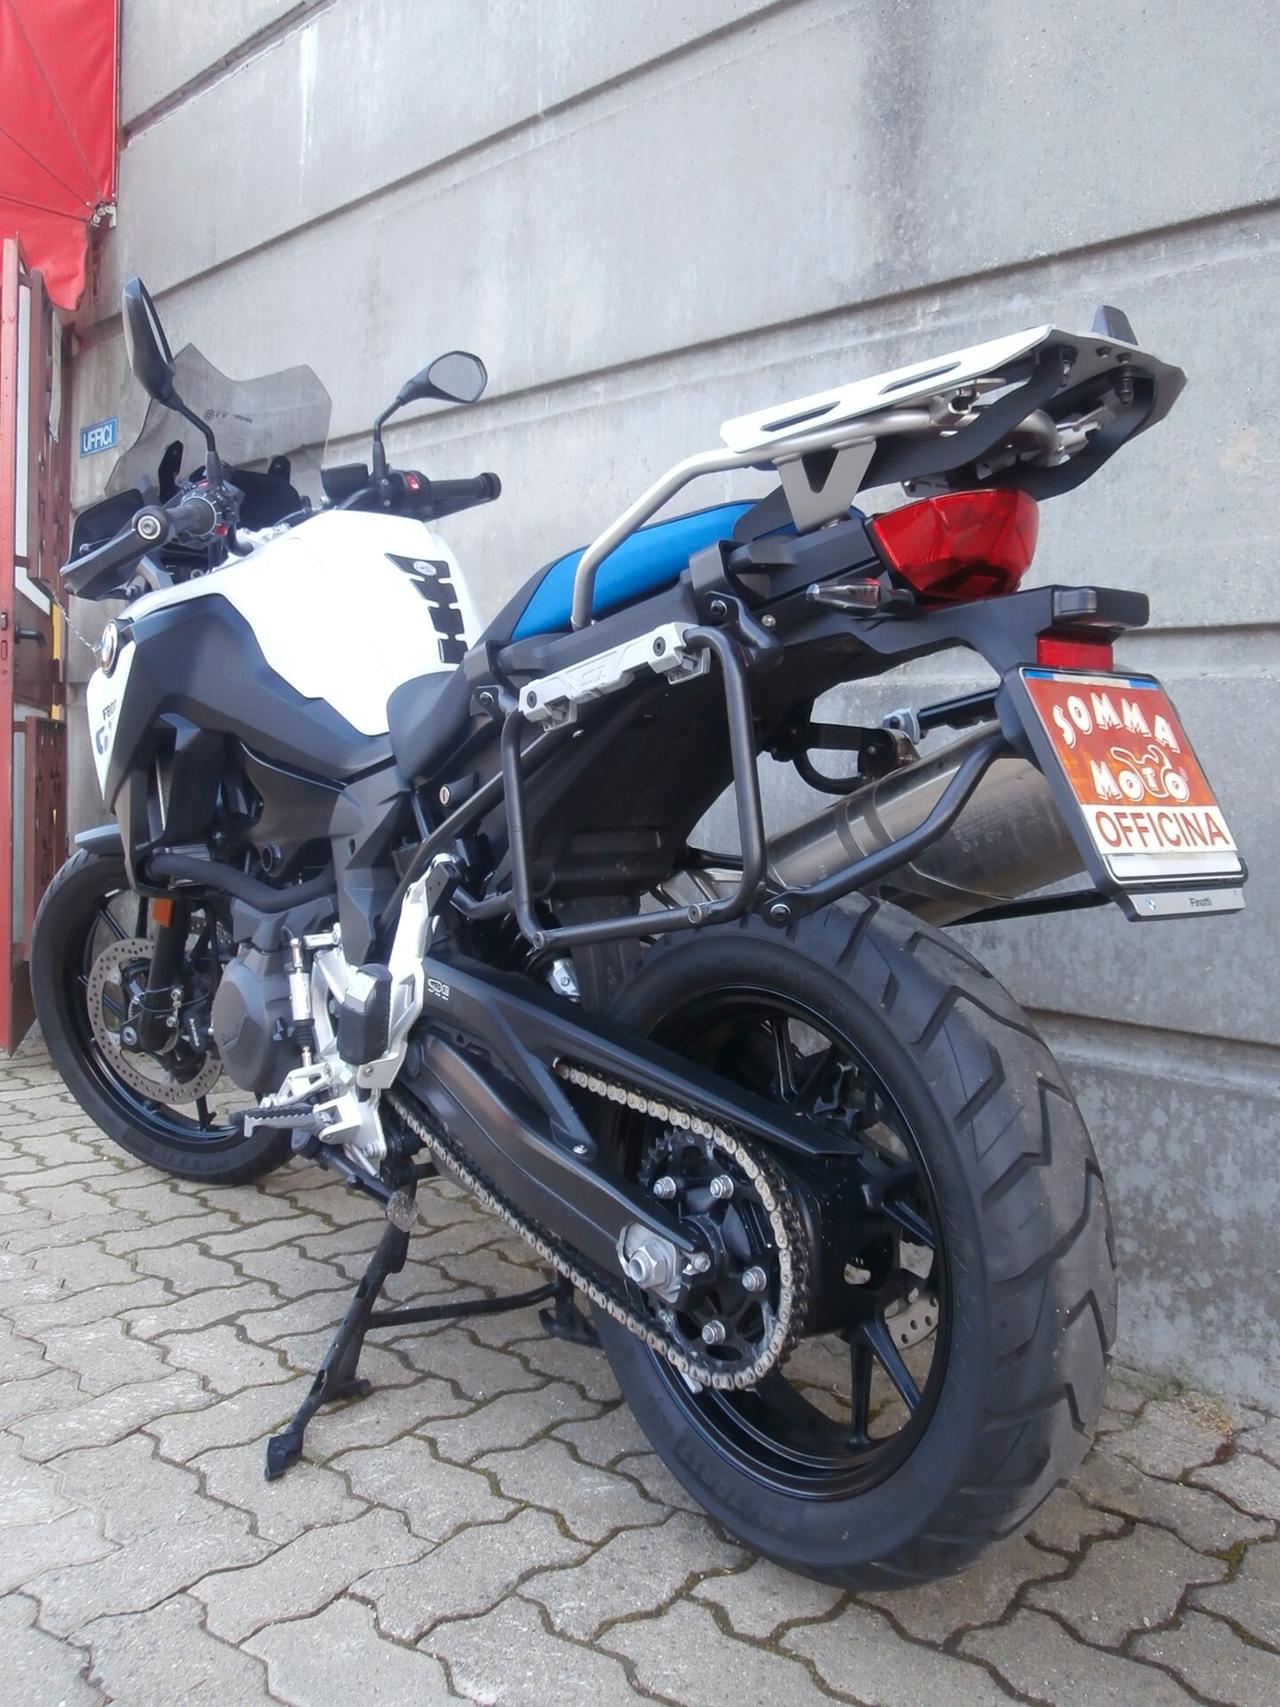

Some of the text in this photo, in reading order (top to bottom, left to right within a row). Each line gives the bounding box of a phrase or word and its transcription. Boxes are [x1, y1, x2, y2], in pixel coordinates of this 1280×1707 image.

[83, 424, 113, 452] UFFICI
[1053, 692, 1181, 753] SOMMA
[1090, 760, 1190, 802] MOTO
[1095, 811, 1231, 848] OFFICINA
